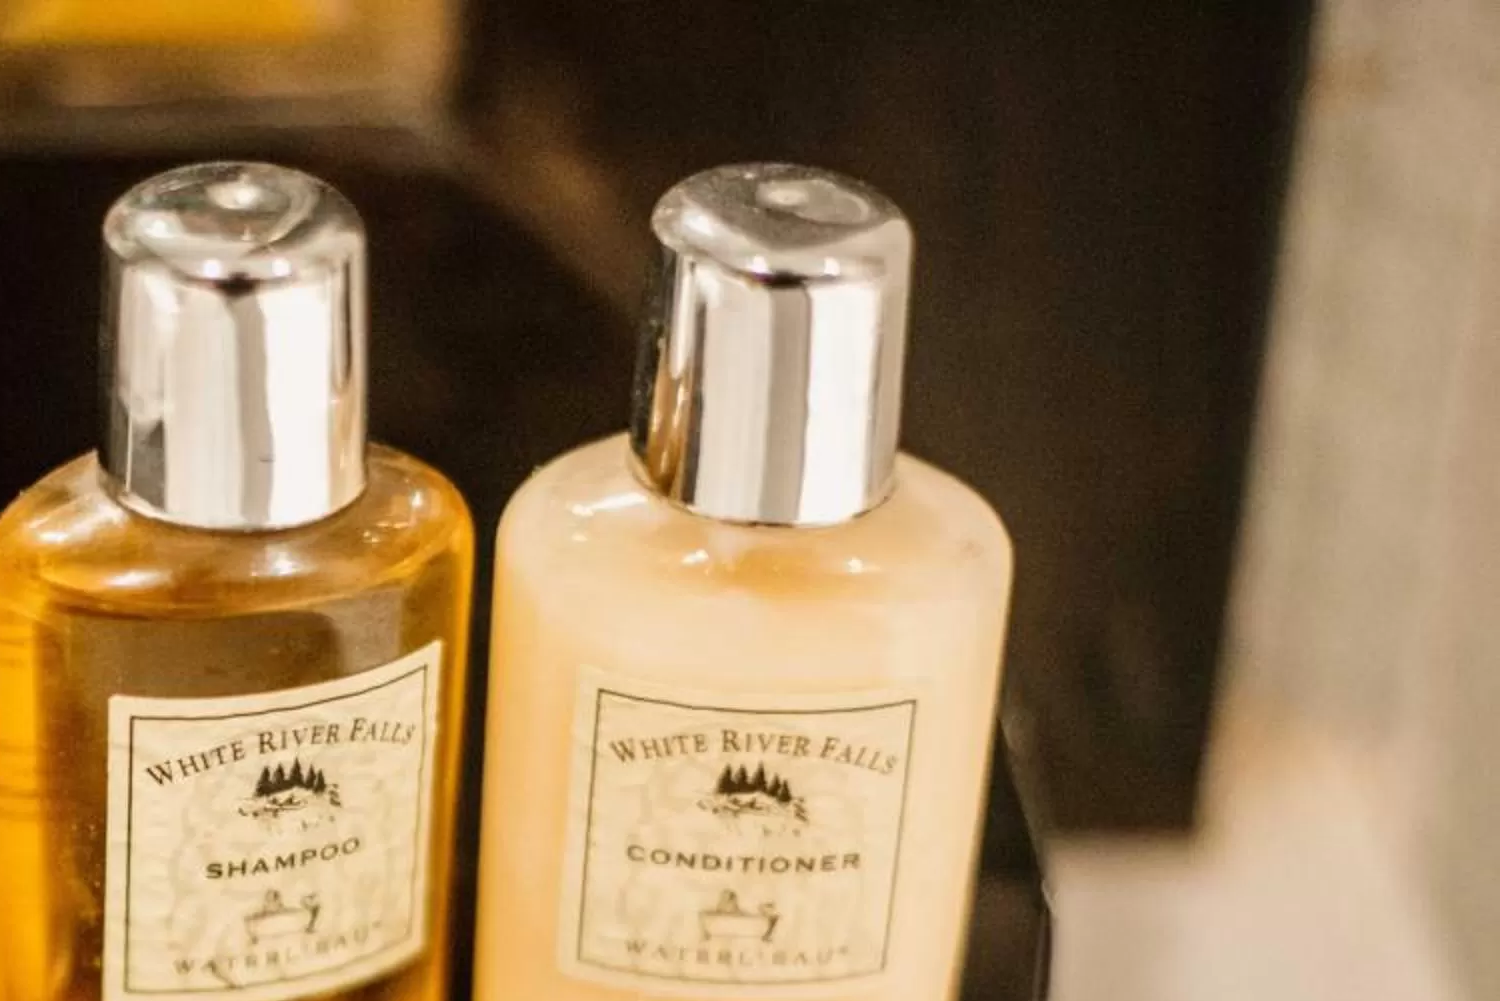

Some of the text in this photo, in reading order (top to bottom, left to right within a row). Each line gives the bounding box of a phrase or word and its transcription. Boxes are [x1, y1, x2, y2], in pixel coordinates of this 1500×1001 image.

[146, 717, 416, 787] WHITE RIVER FALLS
[609, 729, 899, 775] WHITE RIVER FALLS
[206, 837, 361, 879] SHAMPOO
[626, 844, 861, 873] CONDITIONER
